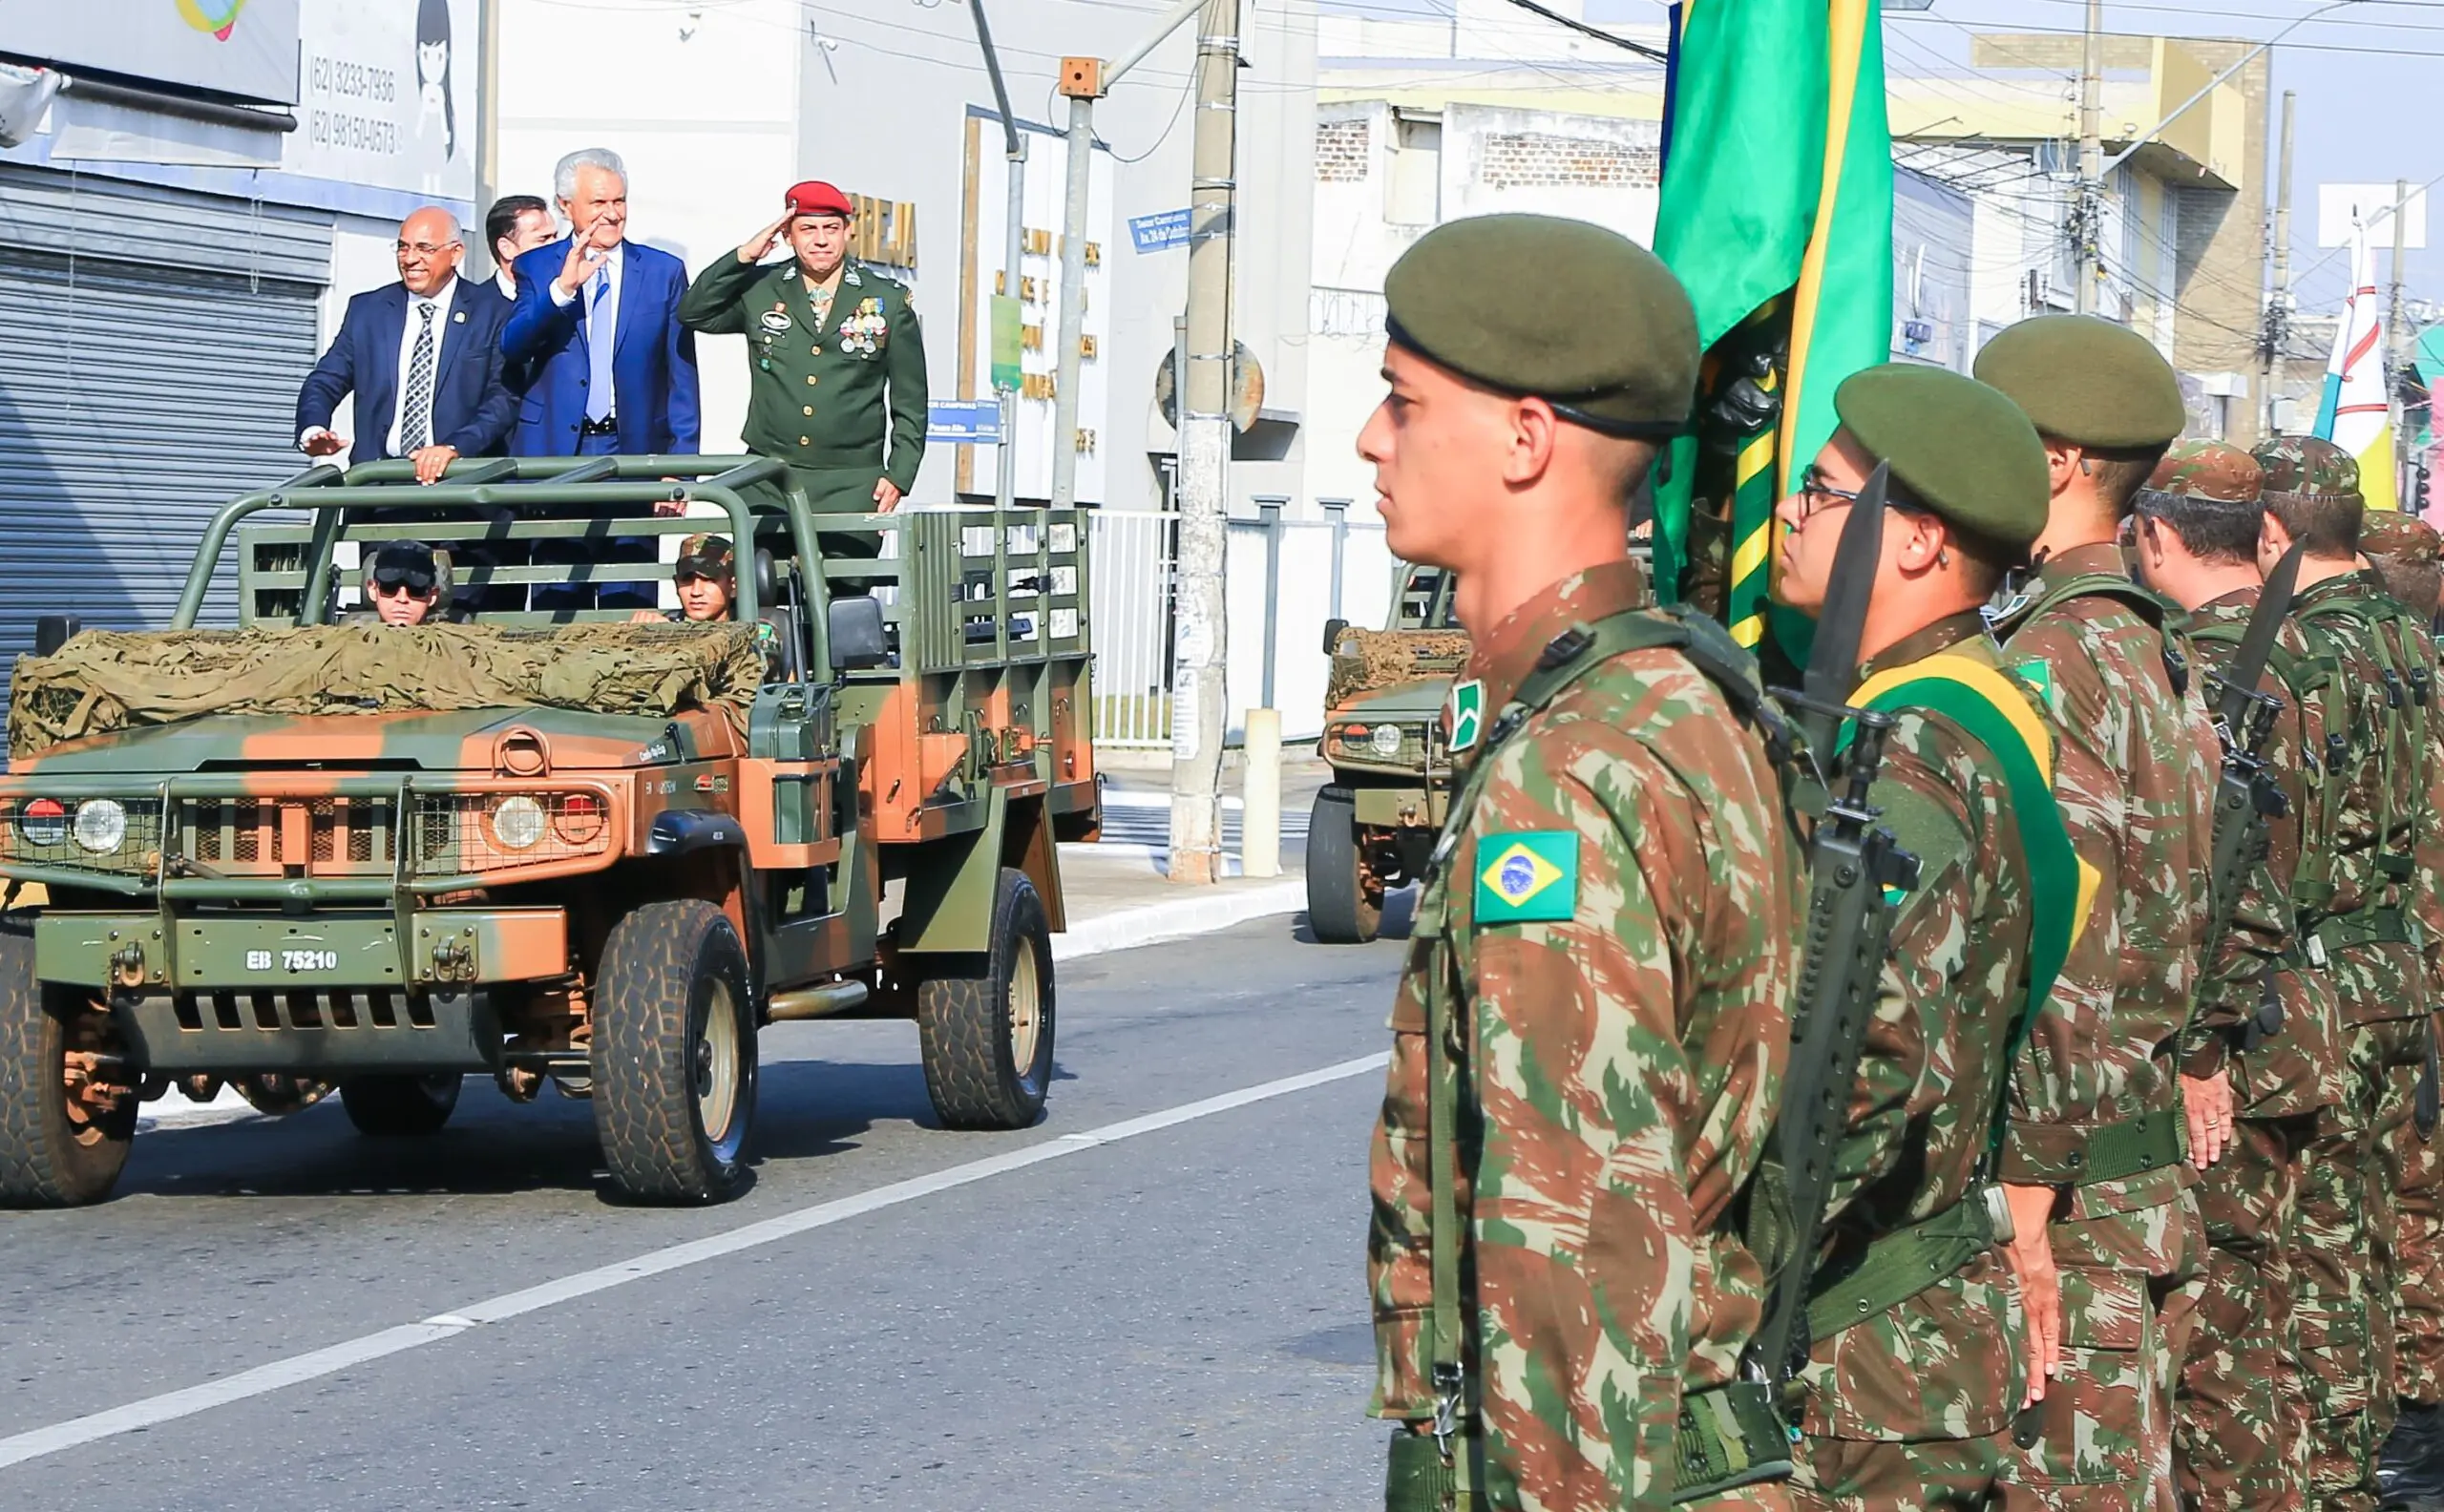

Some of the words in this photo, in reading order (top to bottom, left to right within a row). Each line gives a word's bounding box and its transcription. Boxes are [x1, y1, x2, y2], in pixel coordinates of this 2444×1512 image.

[310, 56, 331, 99] (62)
[335, 61, 394, 102] 3233-7936
[310, 109, 330, 151] (62)
[246, 950, 272, 969] EB
[282, 950, 338, 970] 75210
